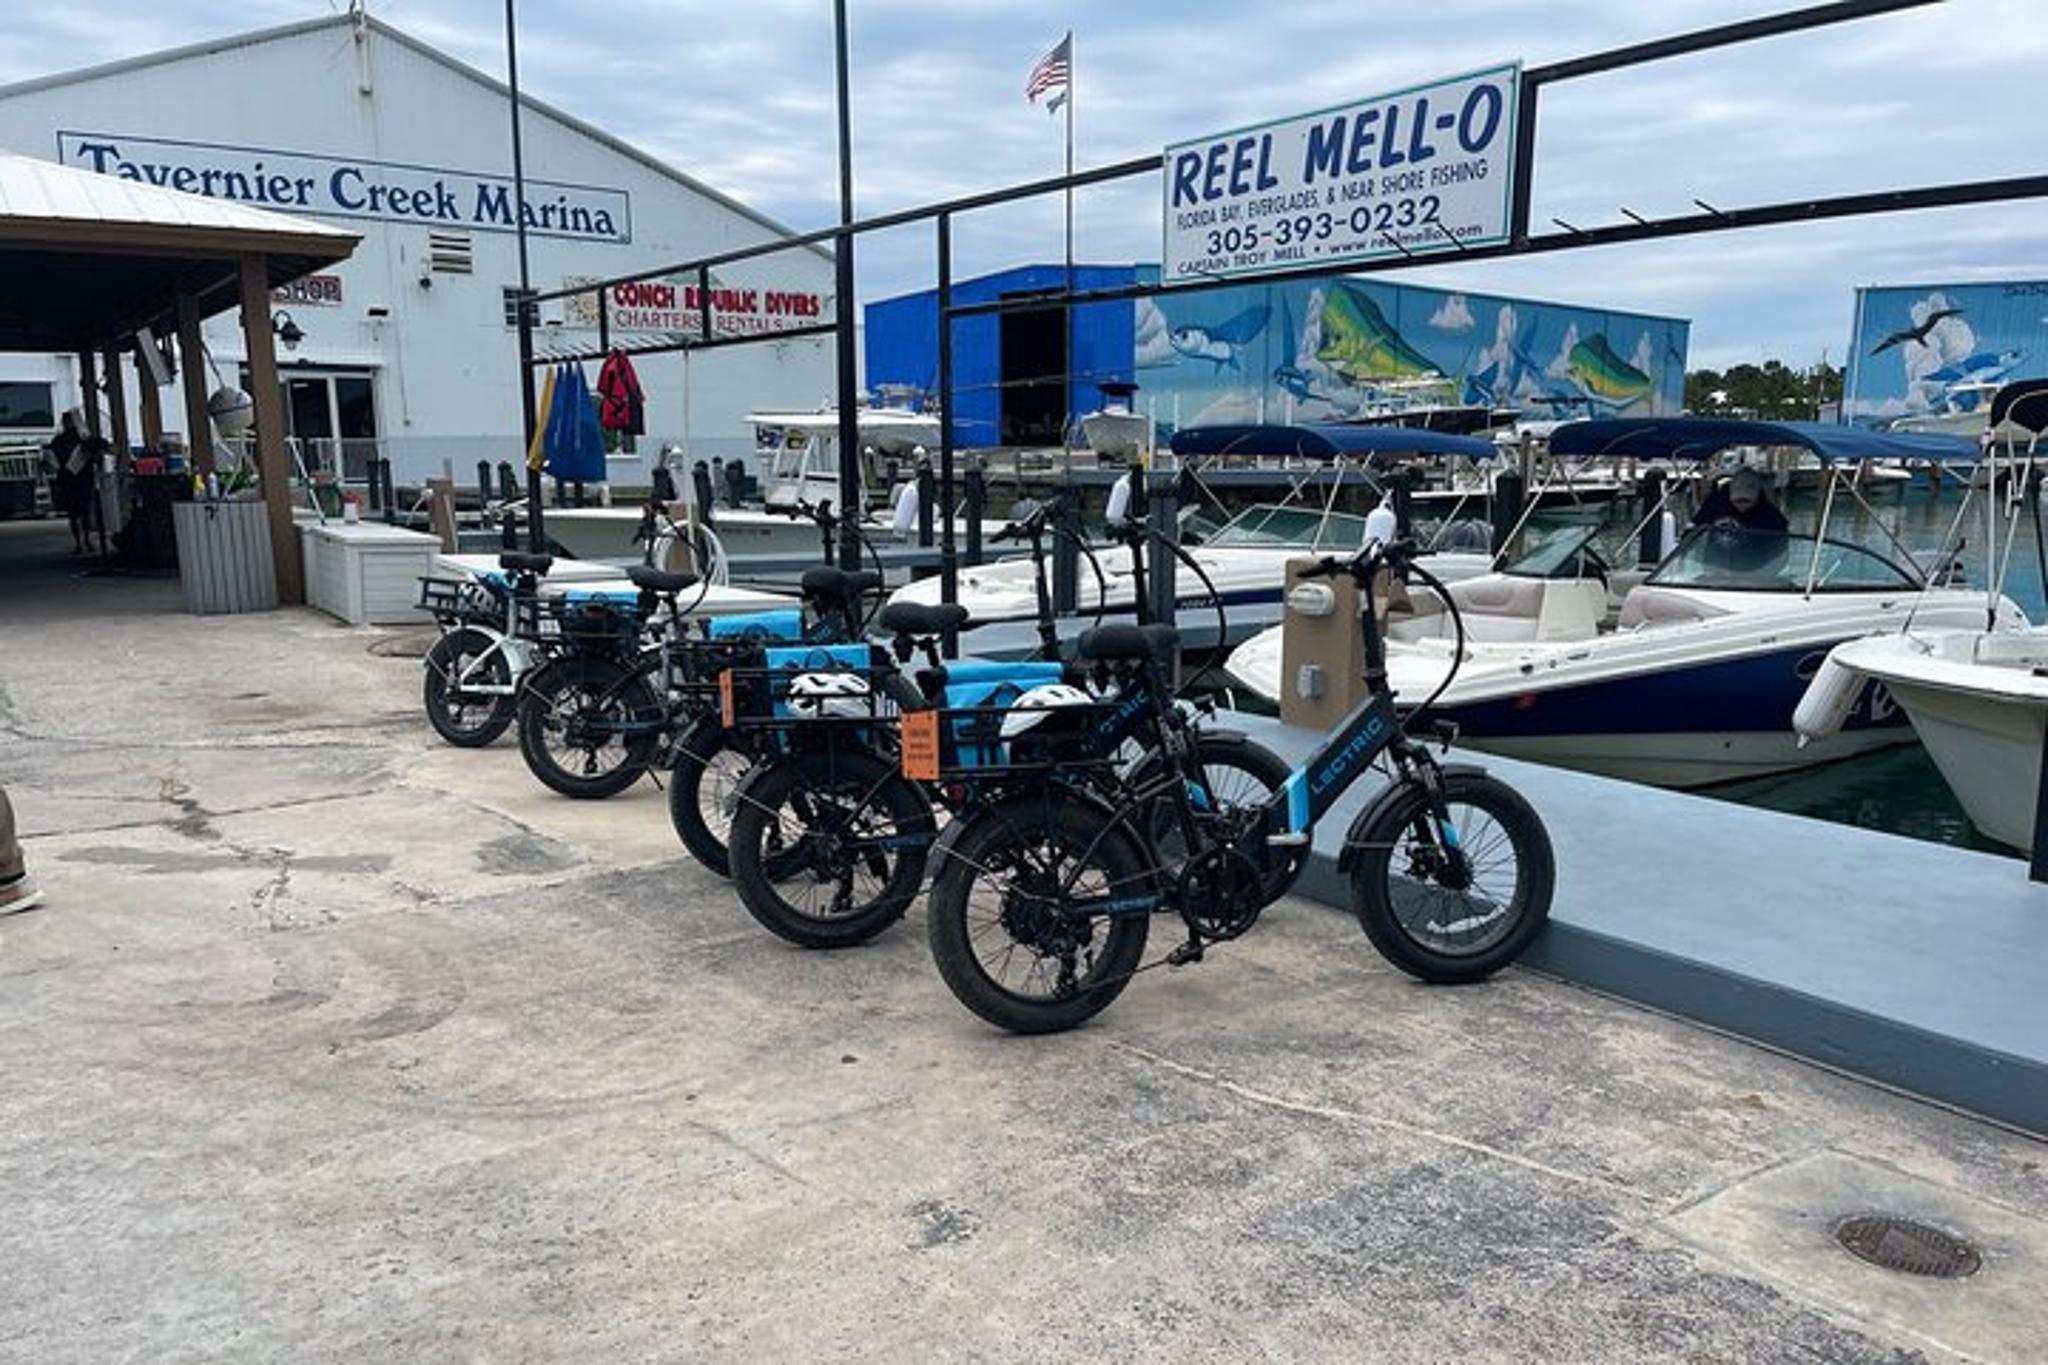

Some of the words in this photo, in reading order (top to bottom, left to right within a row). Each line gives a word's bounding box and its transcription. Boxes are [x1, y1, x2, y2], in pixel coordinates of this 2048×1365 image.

[1173, 133, 1278, 207] REEL
[1303, 84, 1502, 184] MELL-O
[77, 142, 314, 205] Tavernier
[330, 167, 460, 220] Creek
[474, 184, 617, 236] Marina
[1177, 209, 1216, 231] FLORIDA
[1327, 187, 1334, 204] &
[1342, 179, 1374, 201] NEAR
[1382, 170, 1424, 195] SHORE
[1431, 158, 1488, 187] FISHING
[1177, 254, 1229, 275] CAPTAIN
[1234, 252, 1266, 268] TROY
[1274, 246, 1305, 262] MELL
[1329, 225, 1483, 254] www.relmello.om
[1207, 195, 1441, 255] 305-393-0232
[614, 283, 675, 308] CONCH
[765, 291, 819, 317] DIVERS
[615, 309, 702, 329] CHARTERS
[716, 314, 782, 334] RENTALS
[1310, 716, 1384, 795] LECTRIC
